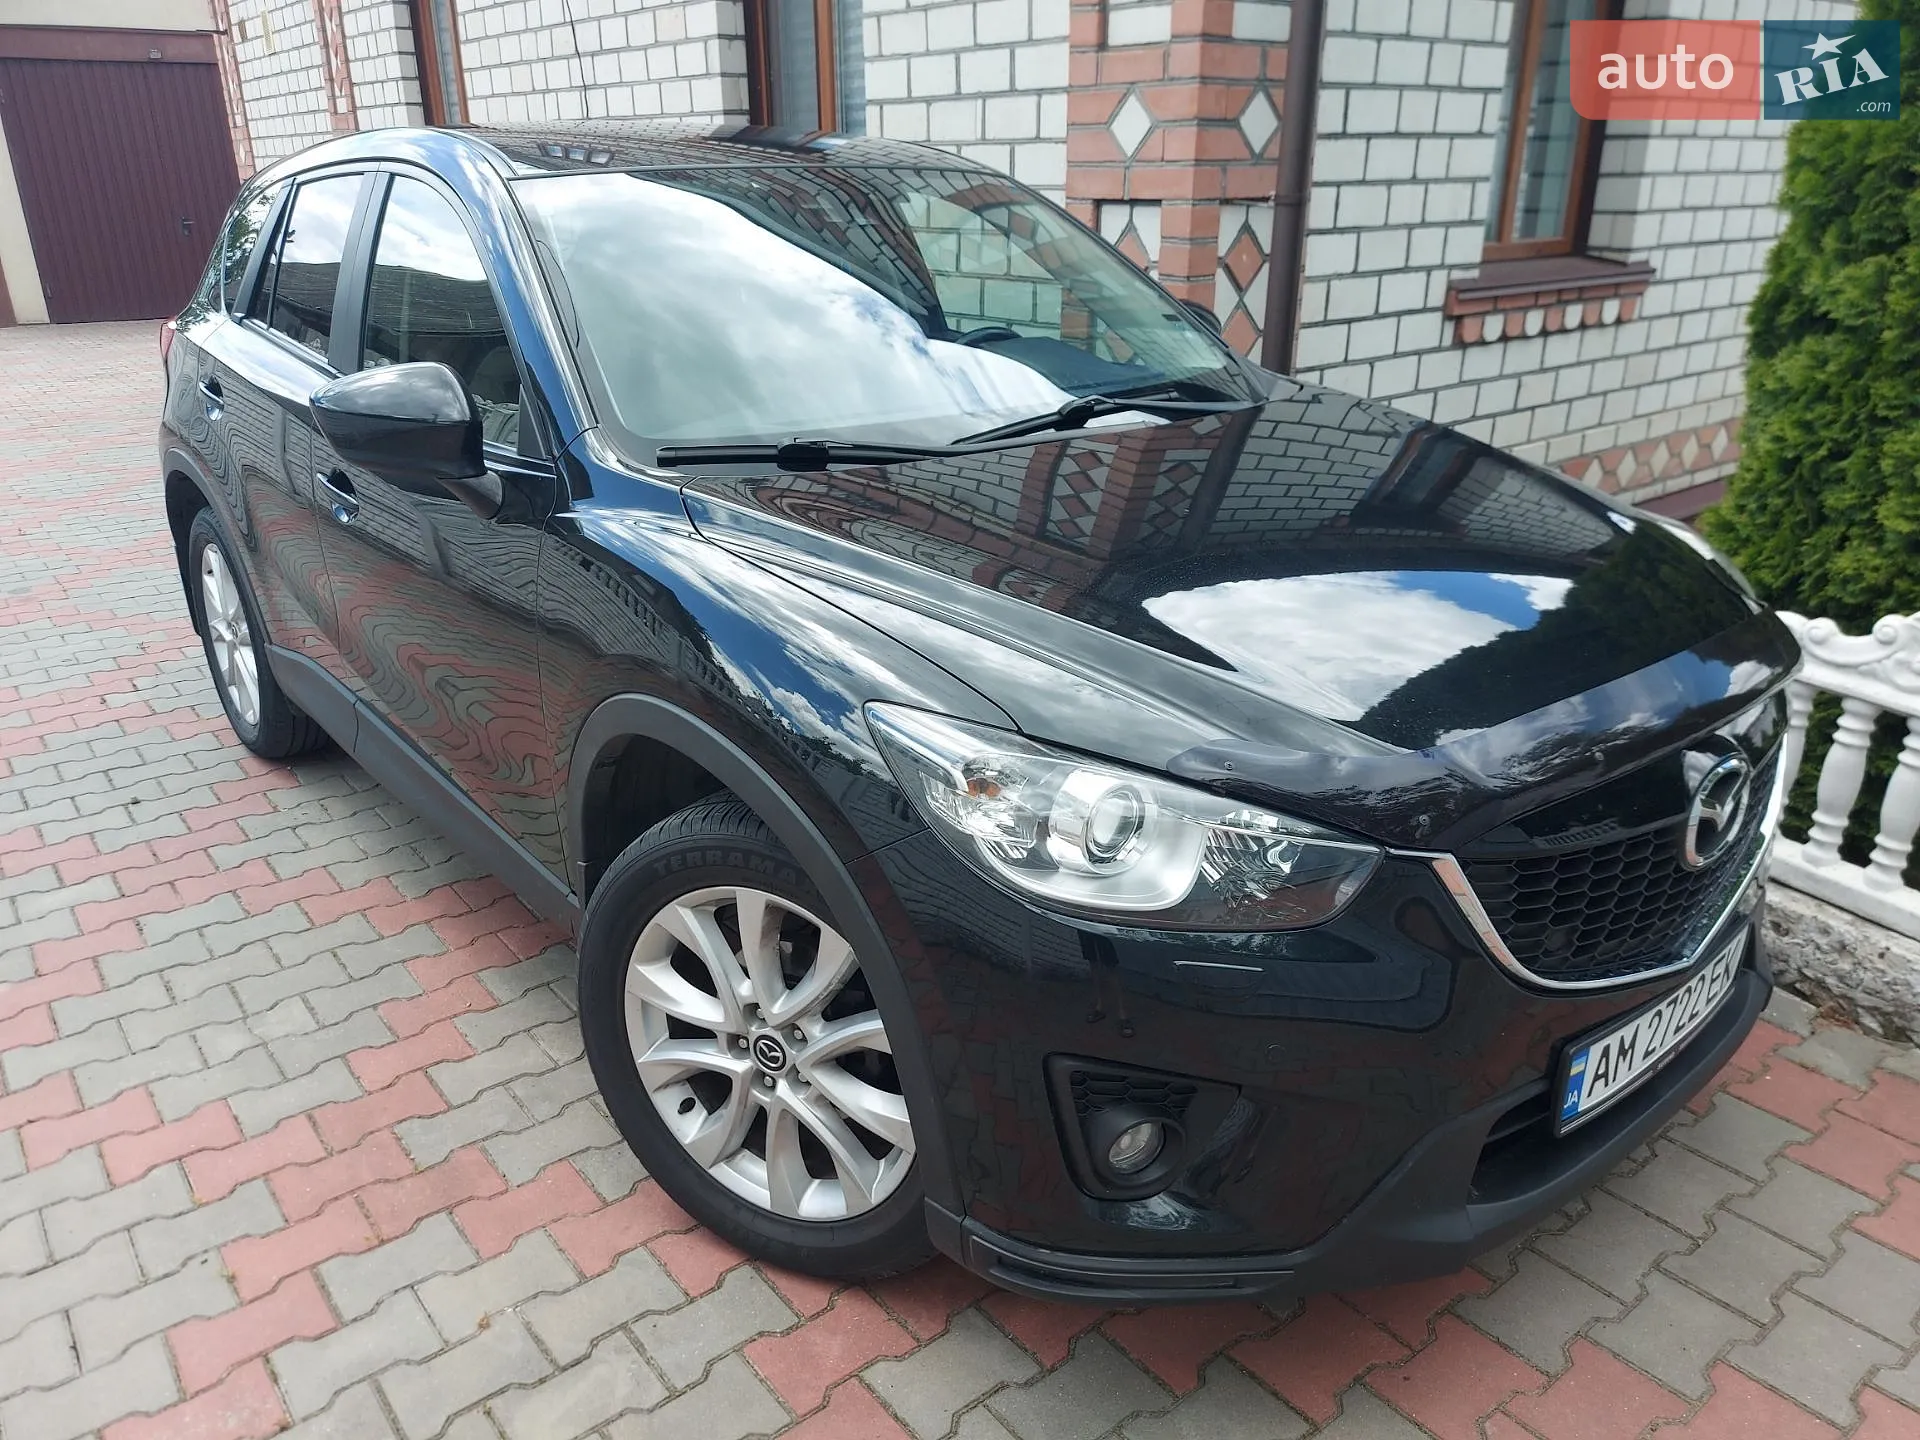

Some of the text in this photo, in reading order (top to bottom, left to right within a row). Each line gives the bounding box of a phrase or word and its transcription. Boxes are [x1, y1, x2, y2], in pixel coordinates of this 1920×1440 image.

[1586, 937, 1742, 1098] AM 2722 EK
